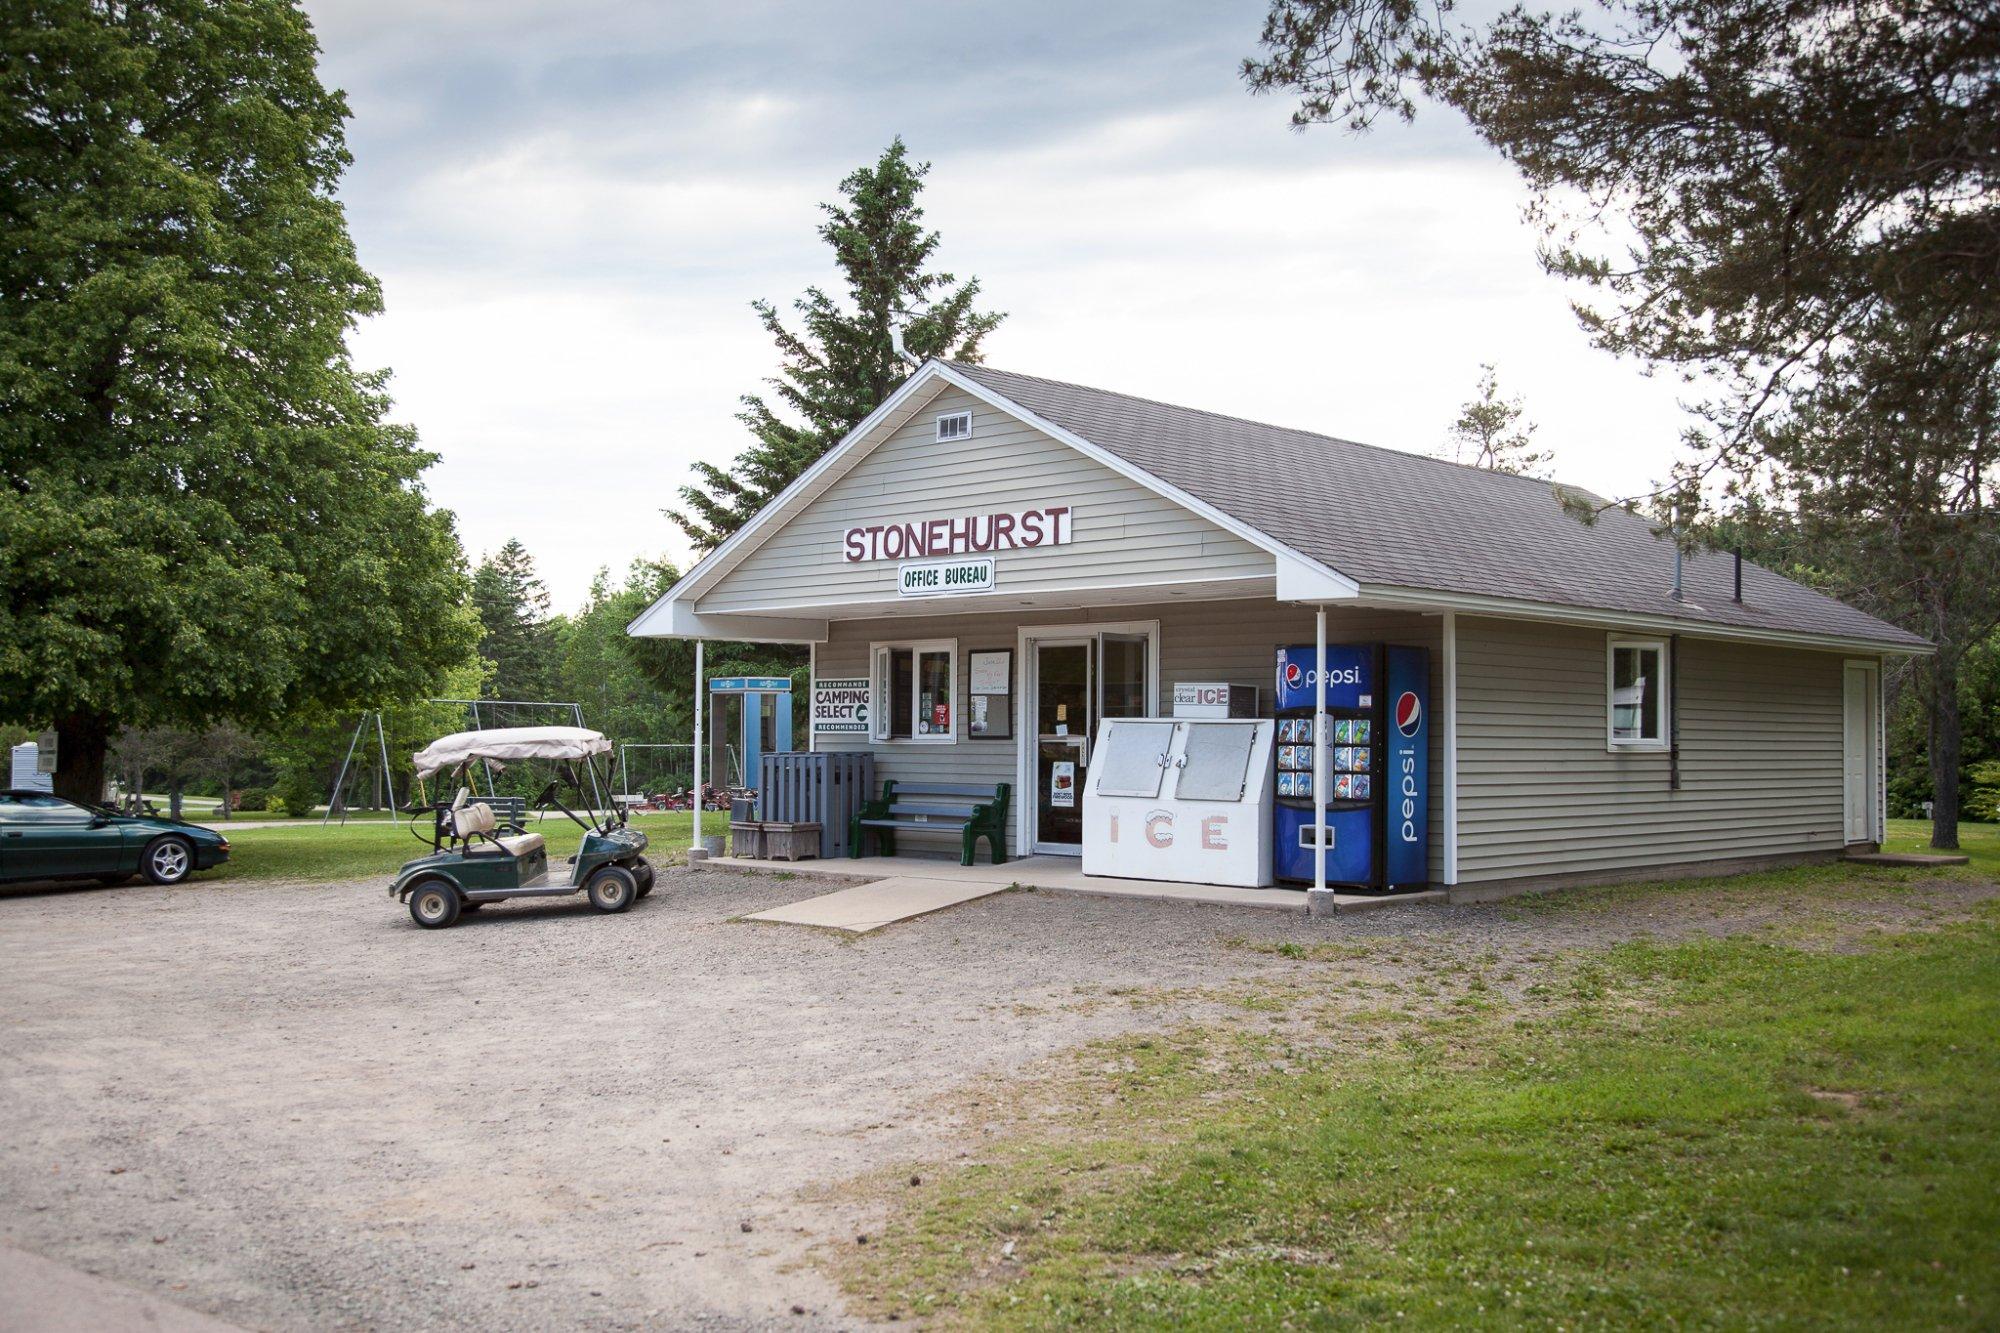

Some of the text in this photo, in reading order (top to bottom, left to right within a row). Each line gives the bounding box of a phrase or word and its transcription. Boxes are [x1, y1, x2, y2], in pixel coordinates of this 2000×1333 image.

[846, 507, 1069, 563] STONEHURST
[904, 565, 987, 588] OFFICE BUREAU
[815, 690, 870, 704] CAMPING
[1174, 693, 1195, 703] clear
[1197, 687, 1228, 704] ICE
[815, 705, 854, 719] SELECT
[1399, 749, 1418, 842] pepsi
[1109, 808, 1229, 851] ICE
